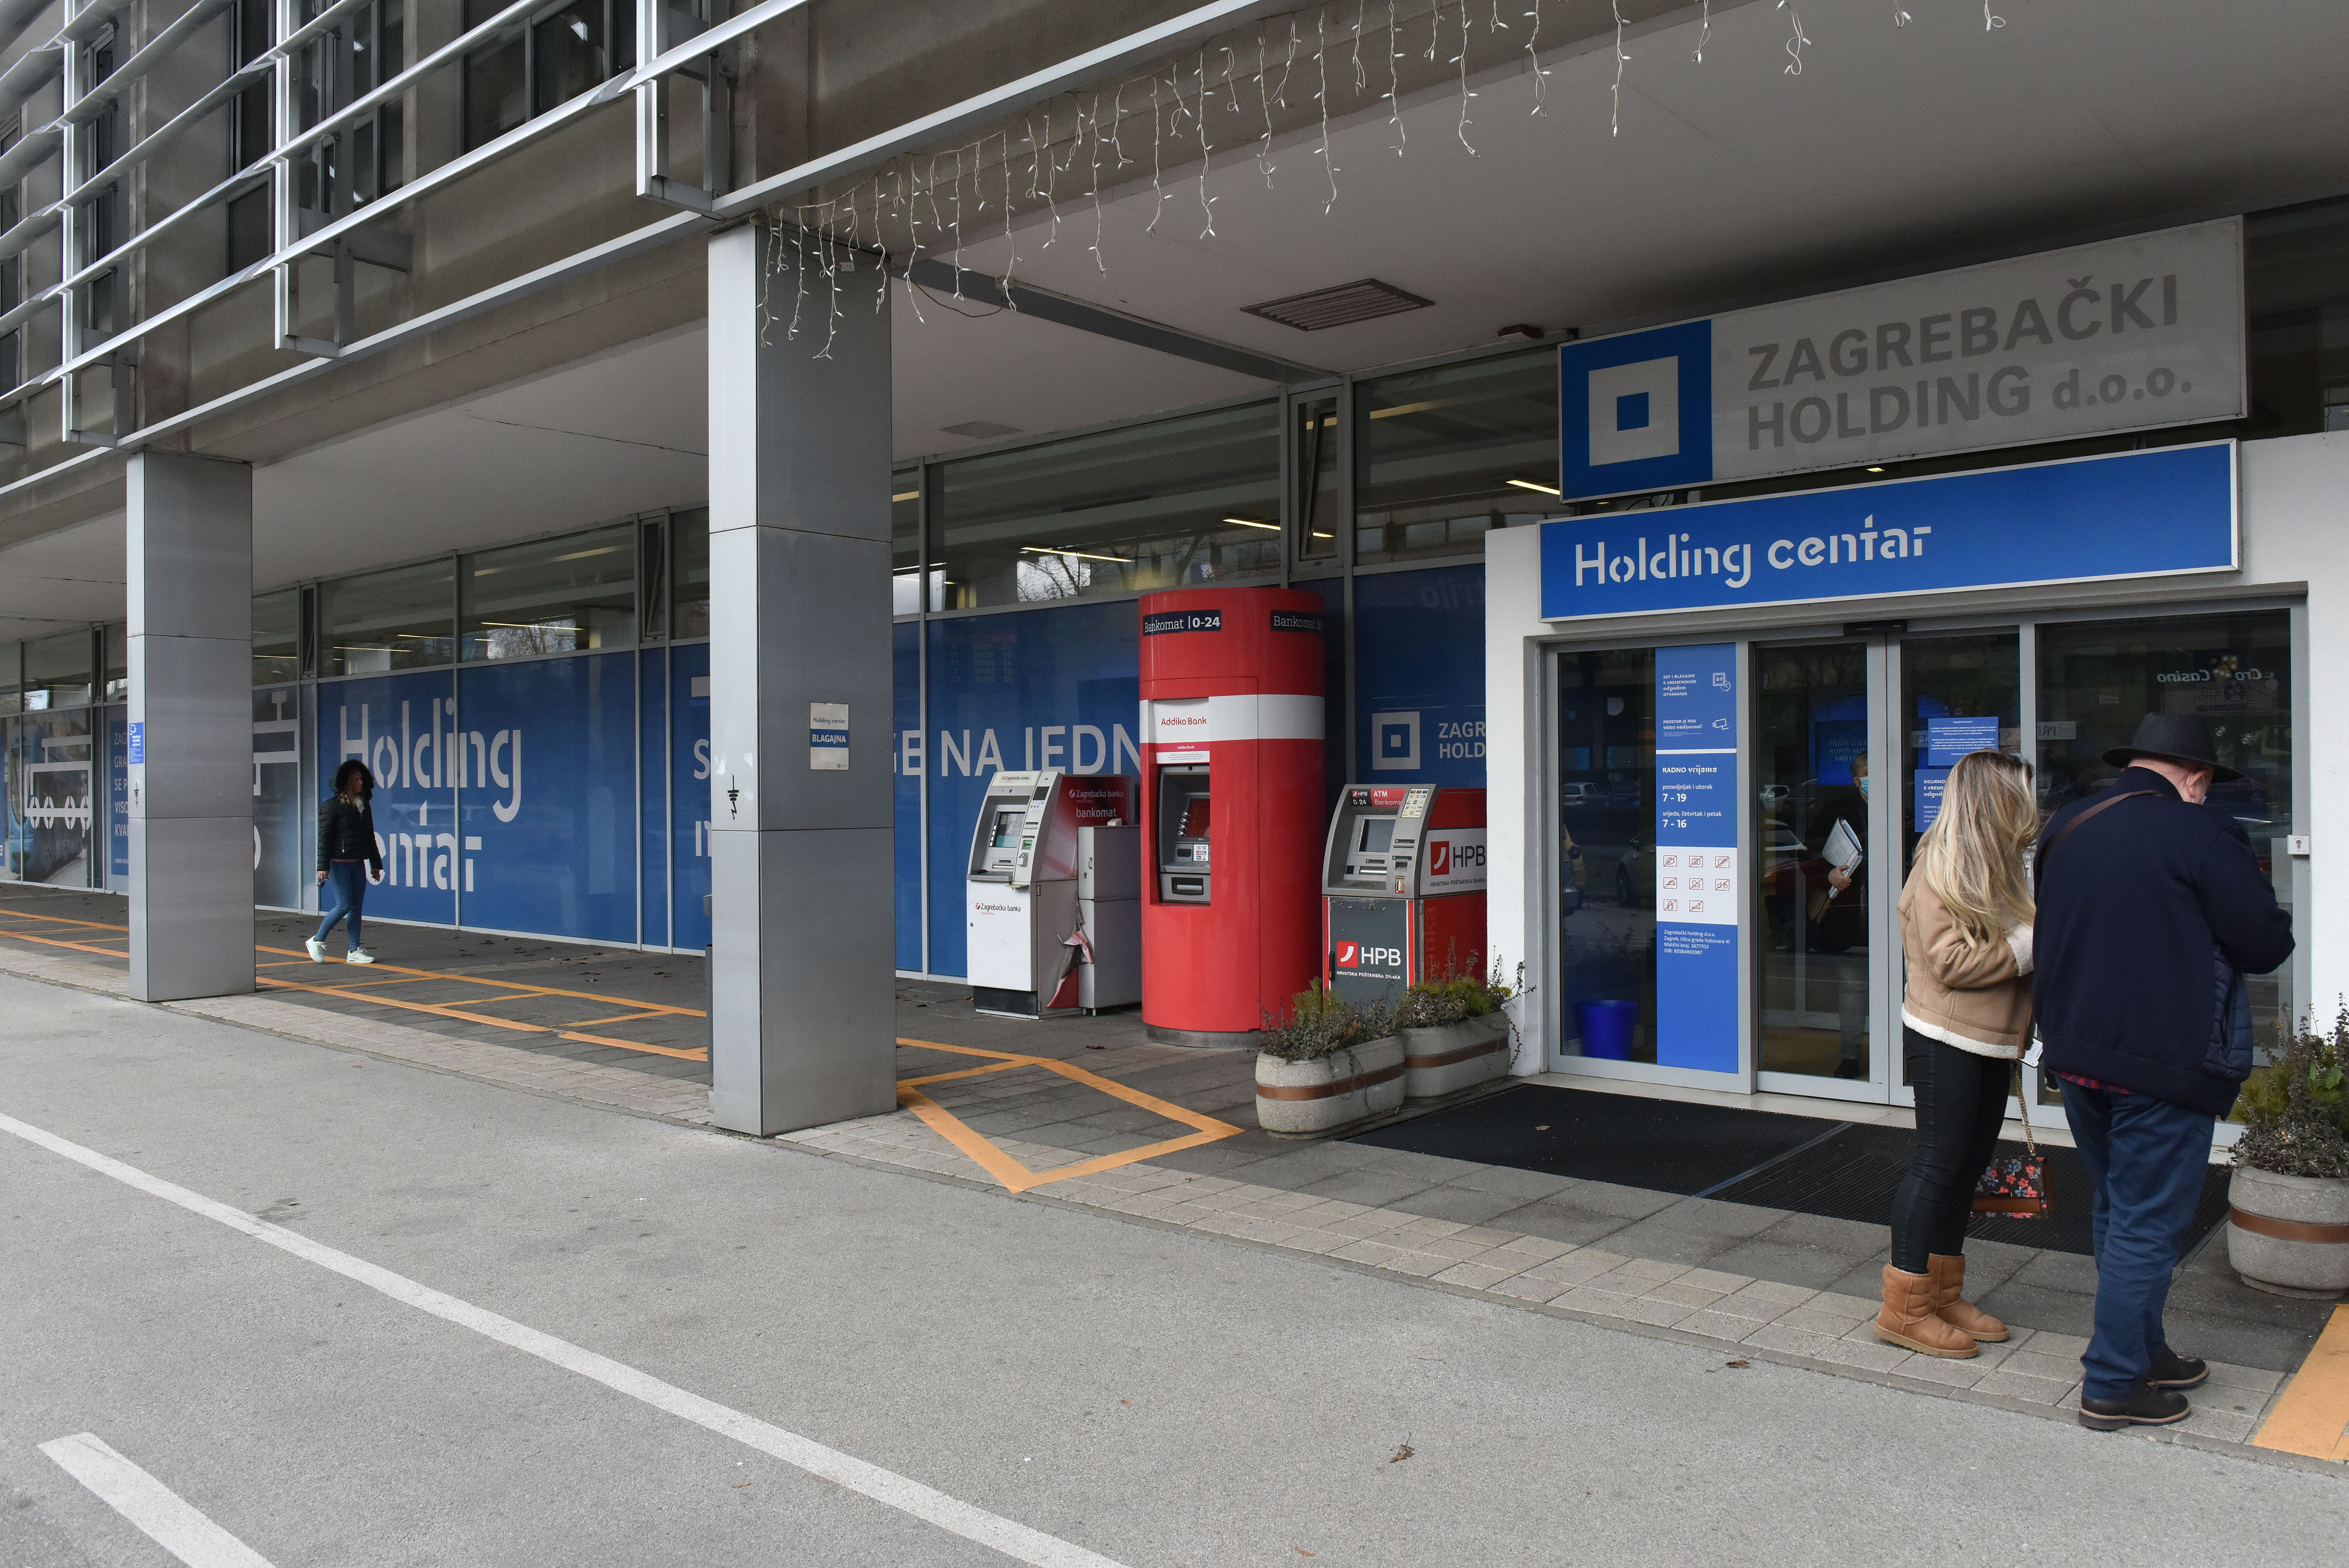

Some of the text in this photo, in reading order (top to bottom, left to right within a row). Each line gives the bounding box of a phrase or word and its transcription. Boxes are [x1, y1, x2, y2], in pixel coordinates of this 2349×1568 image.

[1748, 274, 2178, 391] ZAGREBAČKI
[1749, 365, 2192, 450] HOLDING d.o.o.
[1575, 514, 1931, 587] Holding centar
[1145, 619, 1184, 632] Bankomat
[1274, 615, 1315, 629] Bankomat
[1161, 716, 1207, 725] Addiko Bank
[812, 734, 846, 744] BLAGAJNA
[893, 729, 921, 776] E
[941, 728, 1004, 777] NA
[1439, 742, 1486, 759] HOLD
[340, 697, 521, 822] Holding
[1688, 765, 1718, 775] vrijeme
[115, 779, 122, 791] SE
[1076, 789, 1123, 799] Zagrebačka banka
[1662, 793, 1668, 802] 7
[1677, 793, 1687, 802] 19
[1076, 807, 1117, 818] bankomat
[1663, 819, 1668, 828] 7
[1677, 819, 1687, 828] 16
[364, 799, 482, 892] entar
[1453, 845, 1486, 868] HPB
[981, 903, 1006, 911] Zagrebačka
[1361, 947, 1401, 966] HPB
